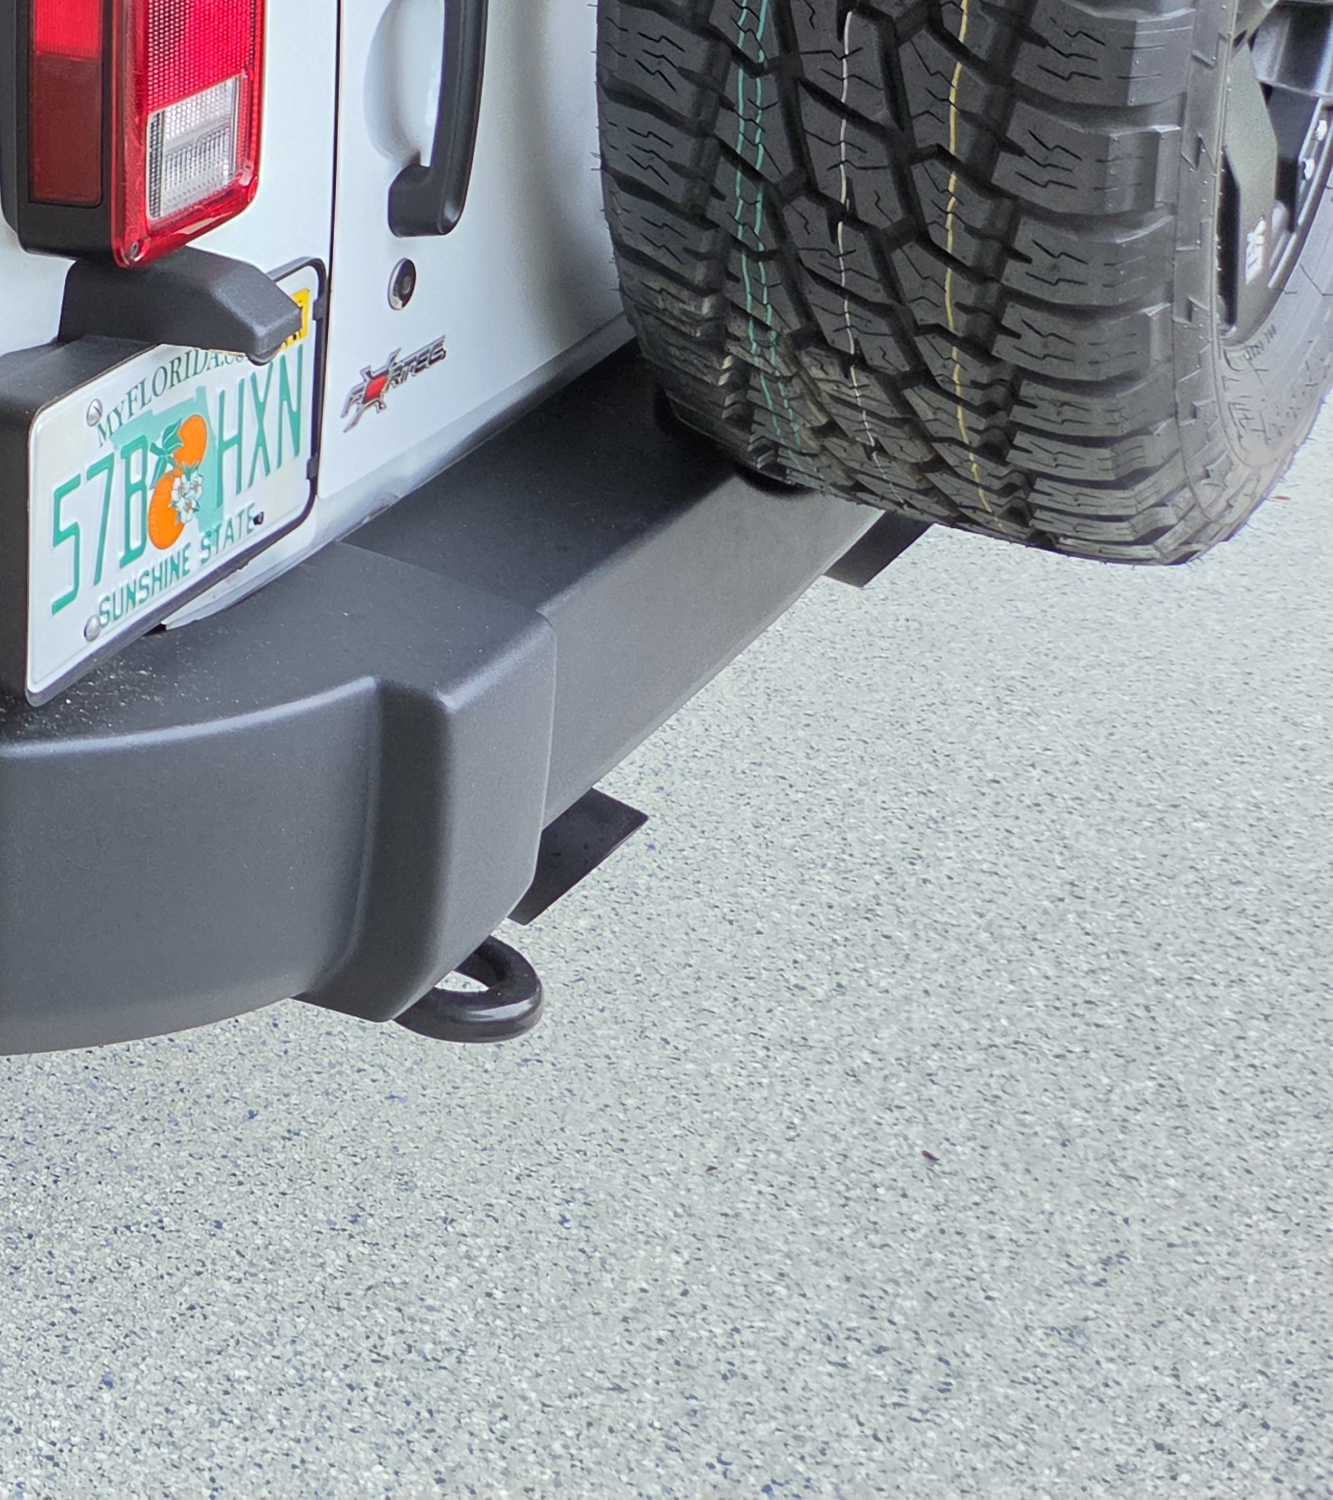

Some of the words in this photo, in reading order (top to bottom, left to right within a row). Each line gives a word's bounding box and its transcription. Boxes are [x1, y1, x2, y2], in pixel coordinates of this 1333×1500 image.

[51, 435, 149, 616] 57B
[216, 343, 304, 512] HXN
[97, 541, 192, 630] SUNSHINE
[199, 501, 257, 565] STATE
